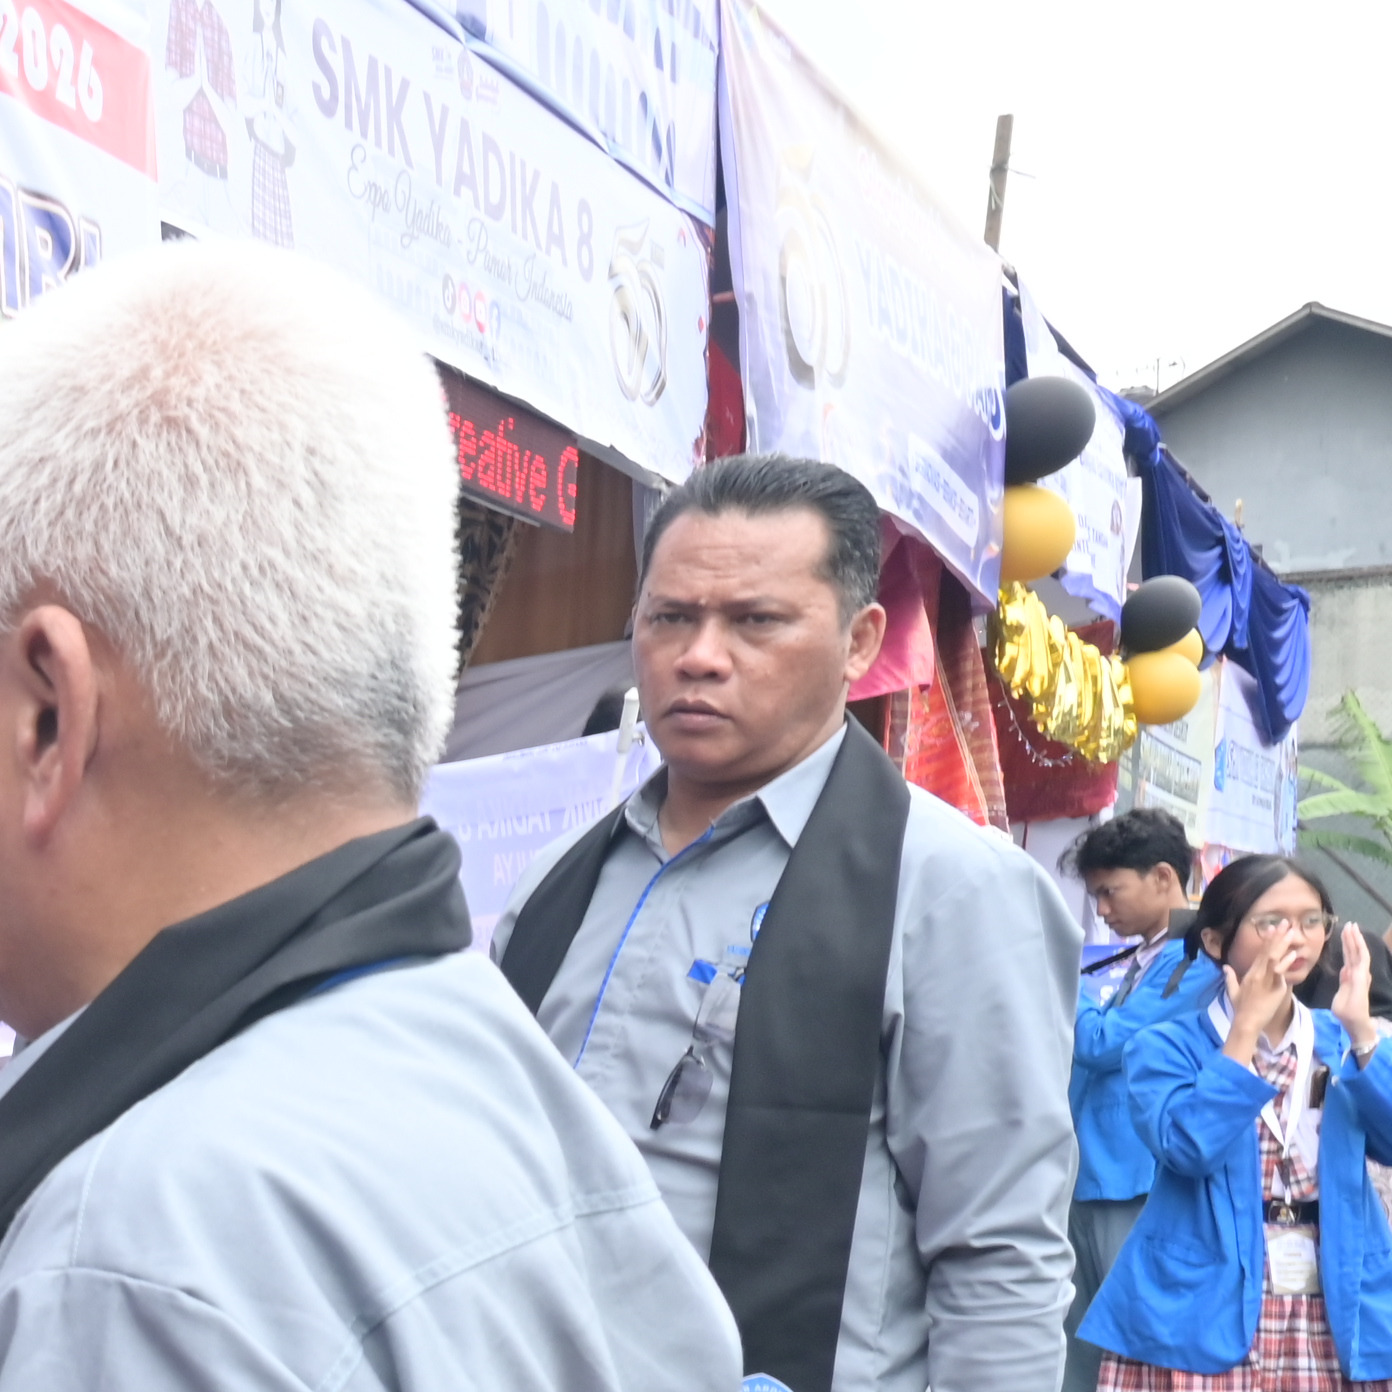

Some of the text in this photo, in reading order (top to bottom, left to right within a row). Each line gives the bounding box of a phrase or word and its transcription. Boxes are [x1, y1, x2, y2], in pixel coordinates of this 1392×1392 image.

[312, 18, 413, 170] SMK
[422, 90, 570, 269] YADIKA
[576, 197, 595, 282] 8
